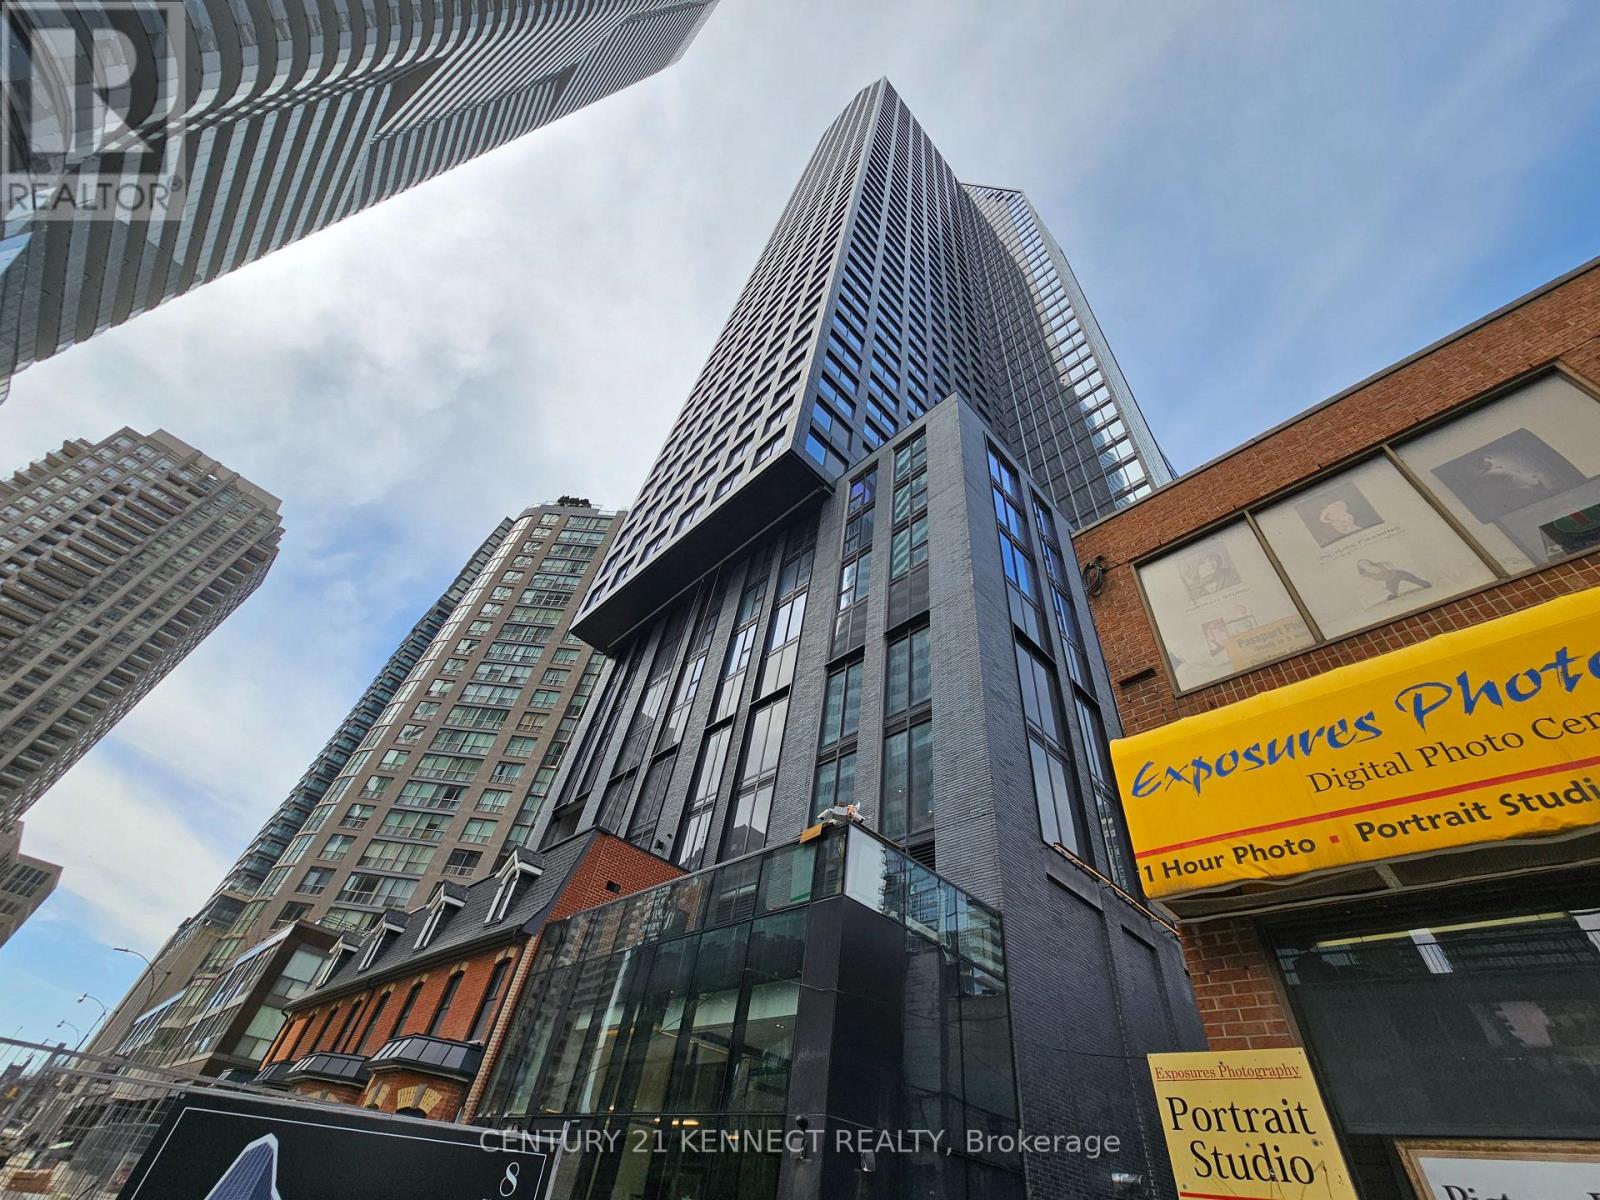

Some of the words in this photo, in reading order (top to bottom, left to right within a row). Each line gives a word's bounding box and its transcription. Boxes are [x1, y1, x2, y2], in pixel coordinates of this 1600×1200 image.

[1131, 711, 1384, 798] Exposures
[1307, 752, 1415, 793] Digital
[1418, 731, 1524, 767] Photo
[1145, 865, 1155, 882] 1
[1162, 851, 1225, 879] Hour
[1233, 836, 1316, 864] Photo
[1355, 800, 1493, 842] Portrait
[1499, 777, 1600, 816] Studi
[1155, 1065, 1216, 1081] Exposures
[1219, 1062, 1302, 1080] Photography
[1165, 1096, 1317, 1135] Portrait
[500, 1161, 520, 1197] 8
[1189, 1140, 1315, 1185] Studio
